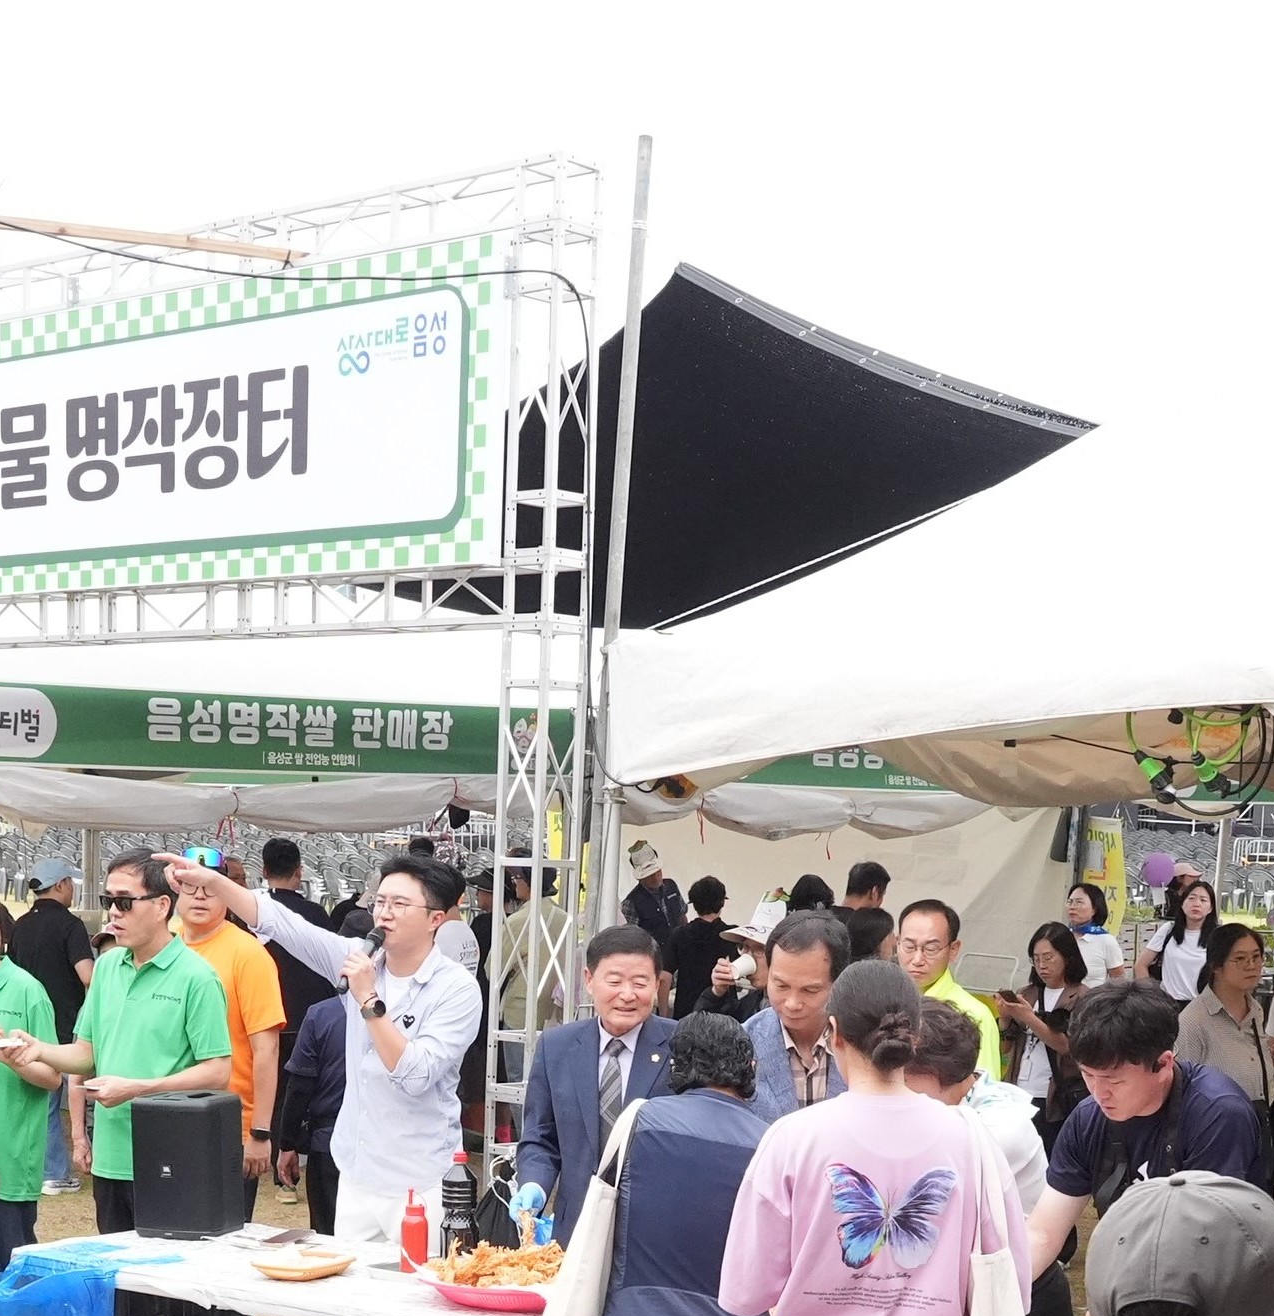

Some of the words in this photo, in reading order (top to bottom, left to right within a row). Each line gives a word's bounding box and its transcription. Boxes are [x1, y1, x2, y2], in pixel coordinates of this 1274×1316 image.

[413, 310, 448, 358] 음성
[65, 364, 310, 502] 명작장터
[146, 696, 339, 748] 음성명작쌀
[351, 706, 454, 751] 판매장
[267, 751, 294, 765] 음성군
[294, 752, 305, 766] 쌀
[331, 753, 356, 767] 연합회
